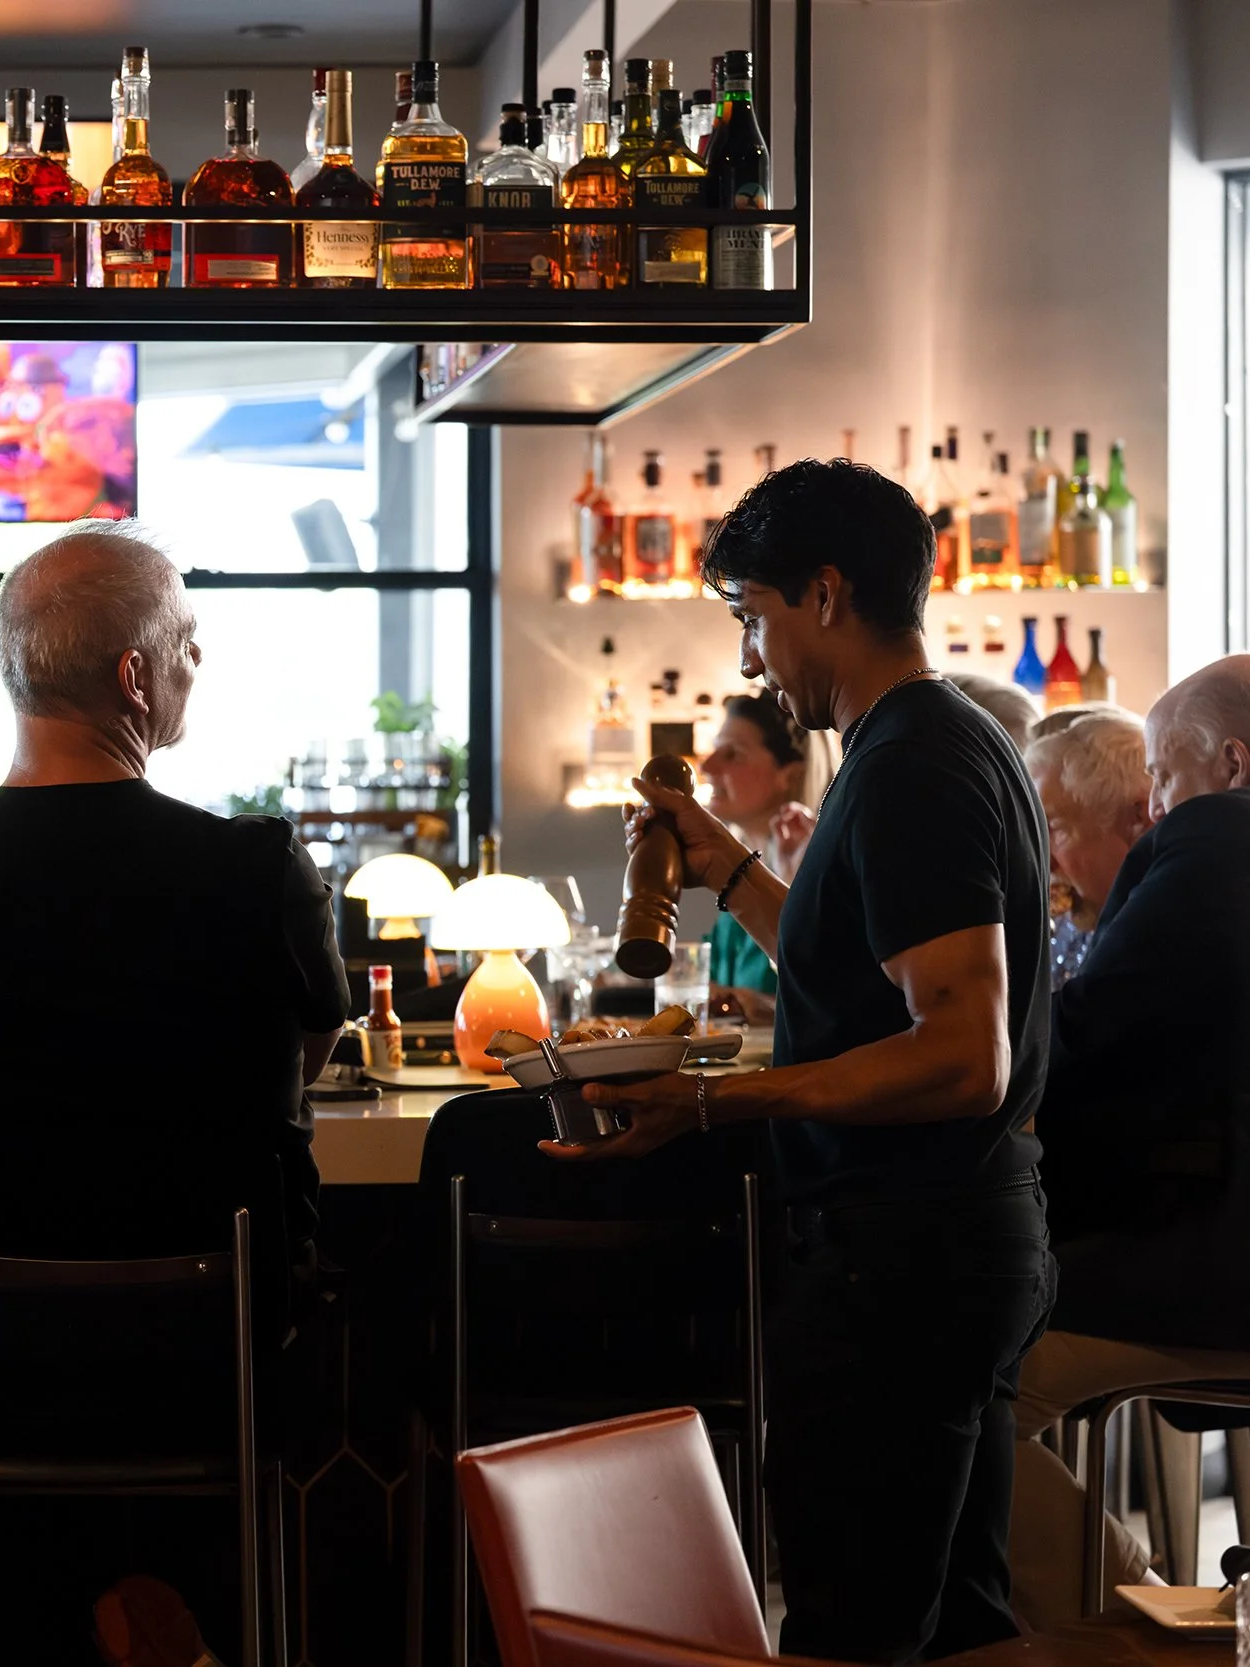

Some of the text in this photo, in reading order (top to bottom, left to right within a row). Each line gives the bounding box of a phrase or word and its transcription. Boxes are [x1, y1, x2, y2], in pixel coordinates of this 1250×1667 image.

[391, 166, 460, 178] TULLAMORE
[488, 191, 531, 208] KNOB
[114, 222, 146, 247] RYE
[317, 231, 370, 243] Hennessy
